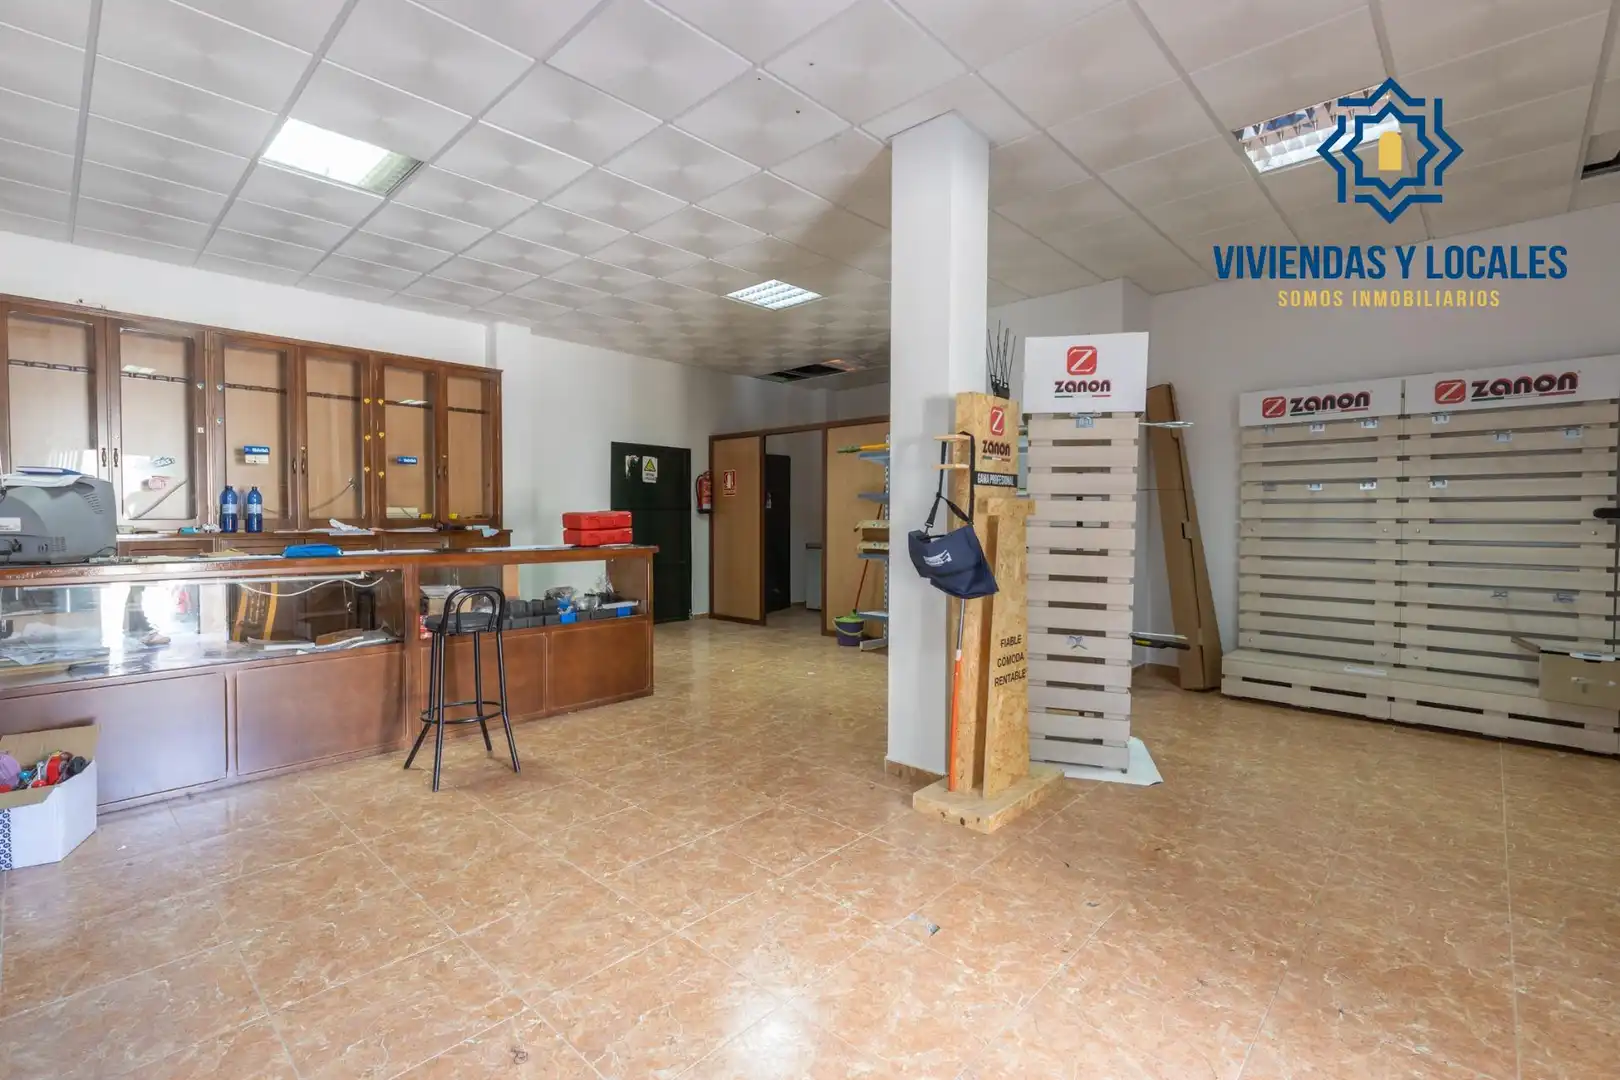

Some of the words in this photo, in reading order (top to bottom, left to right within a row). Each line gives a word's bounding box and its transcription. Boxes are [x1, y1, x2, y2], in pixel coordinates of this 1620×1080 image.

[1054, 380, 1111, 393] zanon
[1471, 371, 1578, 398] zanon
[1290, 391, 1370, 413] zanon
[1000, 634, 1022, 648] FIABLE
[994, 668, 1027, 687] RENTABLE
